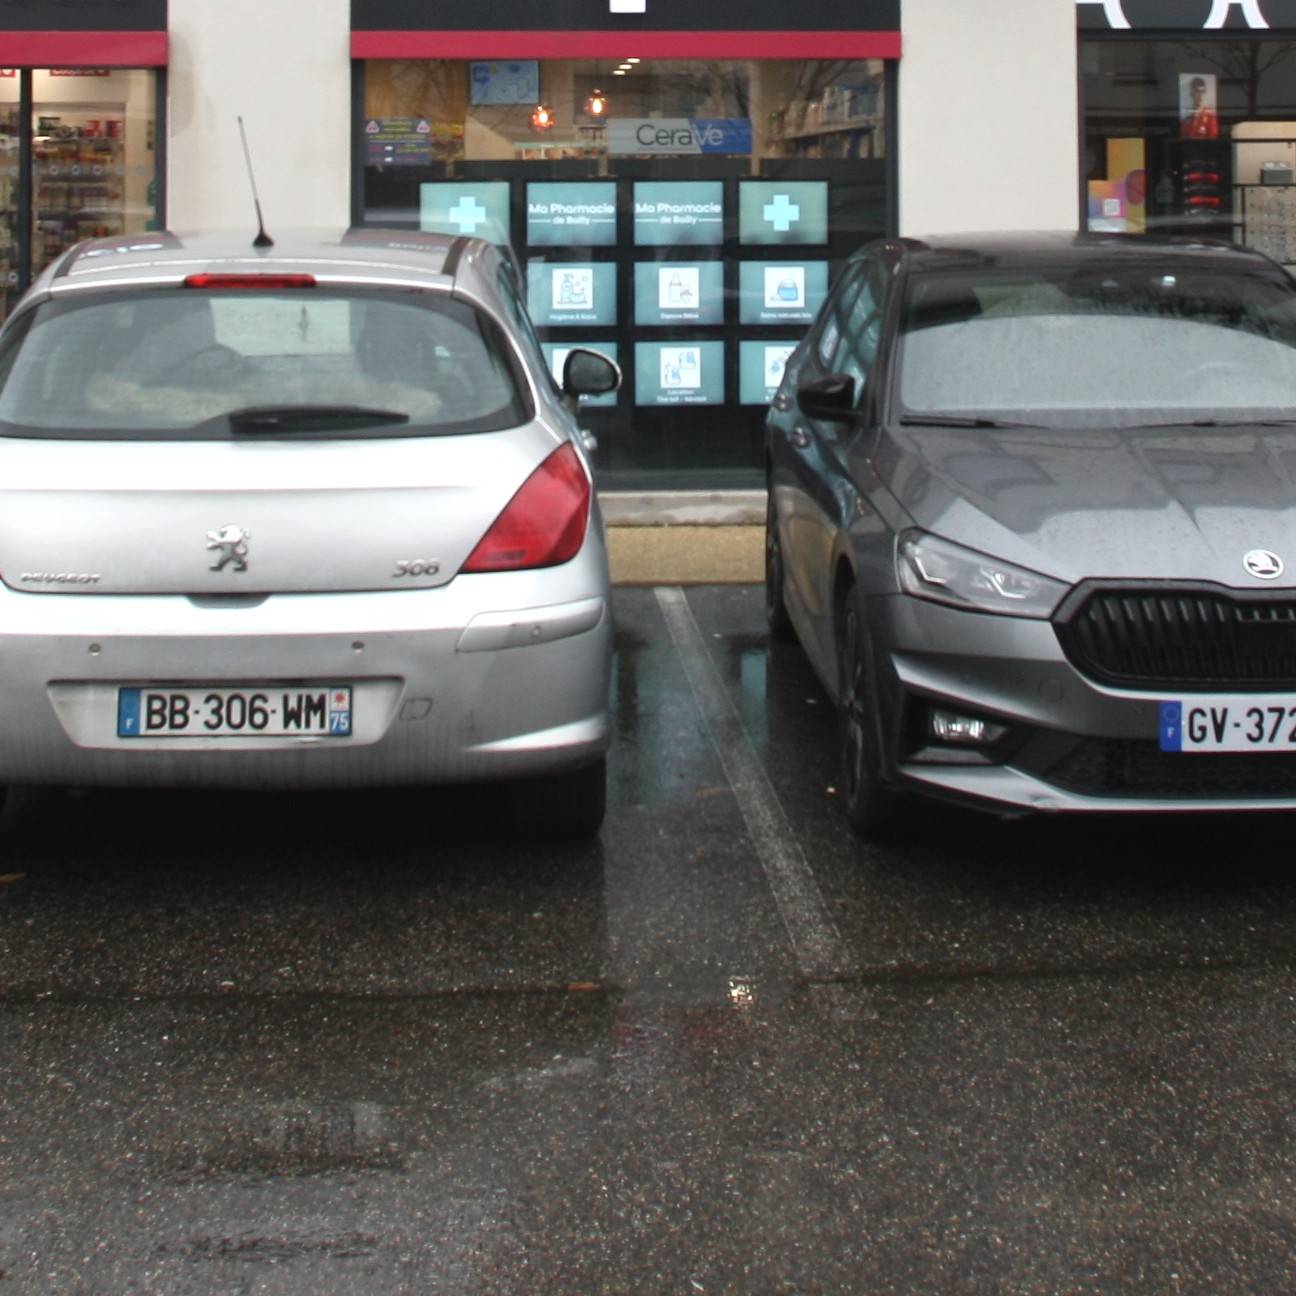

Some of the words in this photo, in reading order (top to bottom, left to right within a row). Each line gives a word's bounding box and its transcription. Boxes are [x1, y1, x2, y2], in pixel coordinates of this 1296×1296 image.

[636, 123, 724, 147] CeraVe
[529, 204, 548, 215] Ma
[550, 202, 615, 215] Pharmacie
[635, 203, 655, 214] Ma
[657, 201, 722, 214] Pharmacie
[552, 215, 565, 225] de
[660, 214, 672, 224] de
[392, 559, 440, 576] 308
[21, 572, 101, 583] PEUGEOT
[125, 718, 133, 729] F
[145, 693, 326, 730] BB-306-WM
[331, 712, 348, 731] 75
[1167, 727, 1175, 738] F
